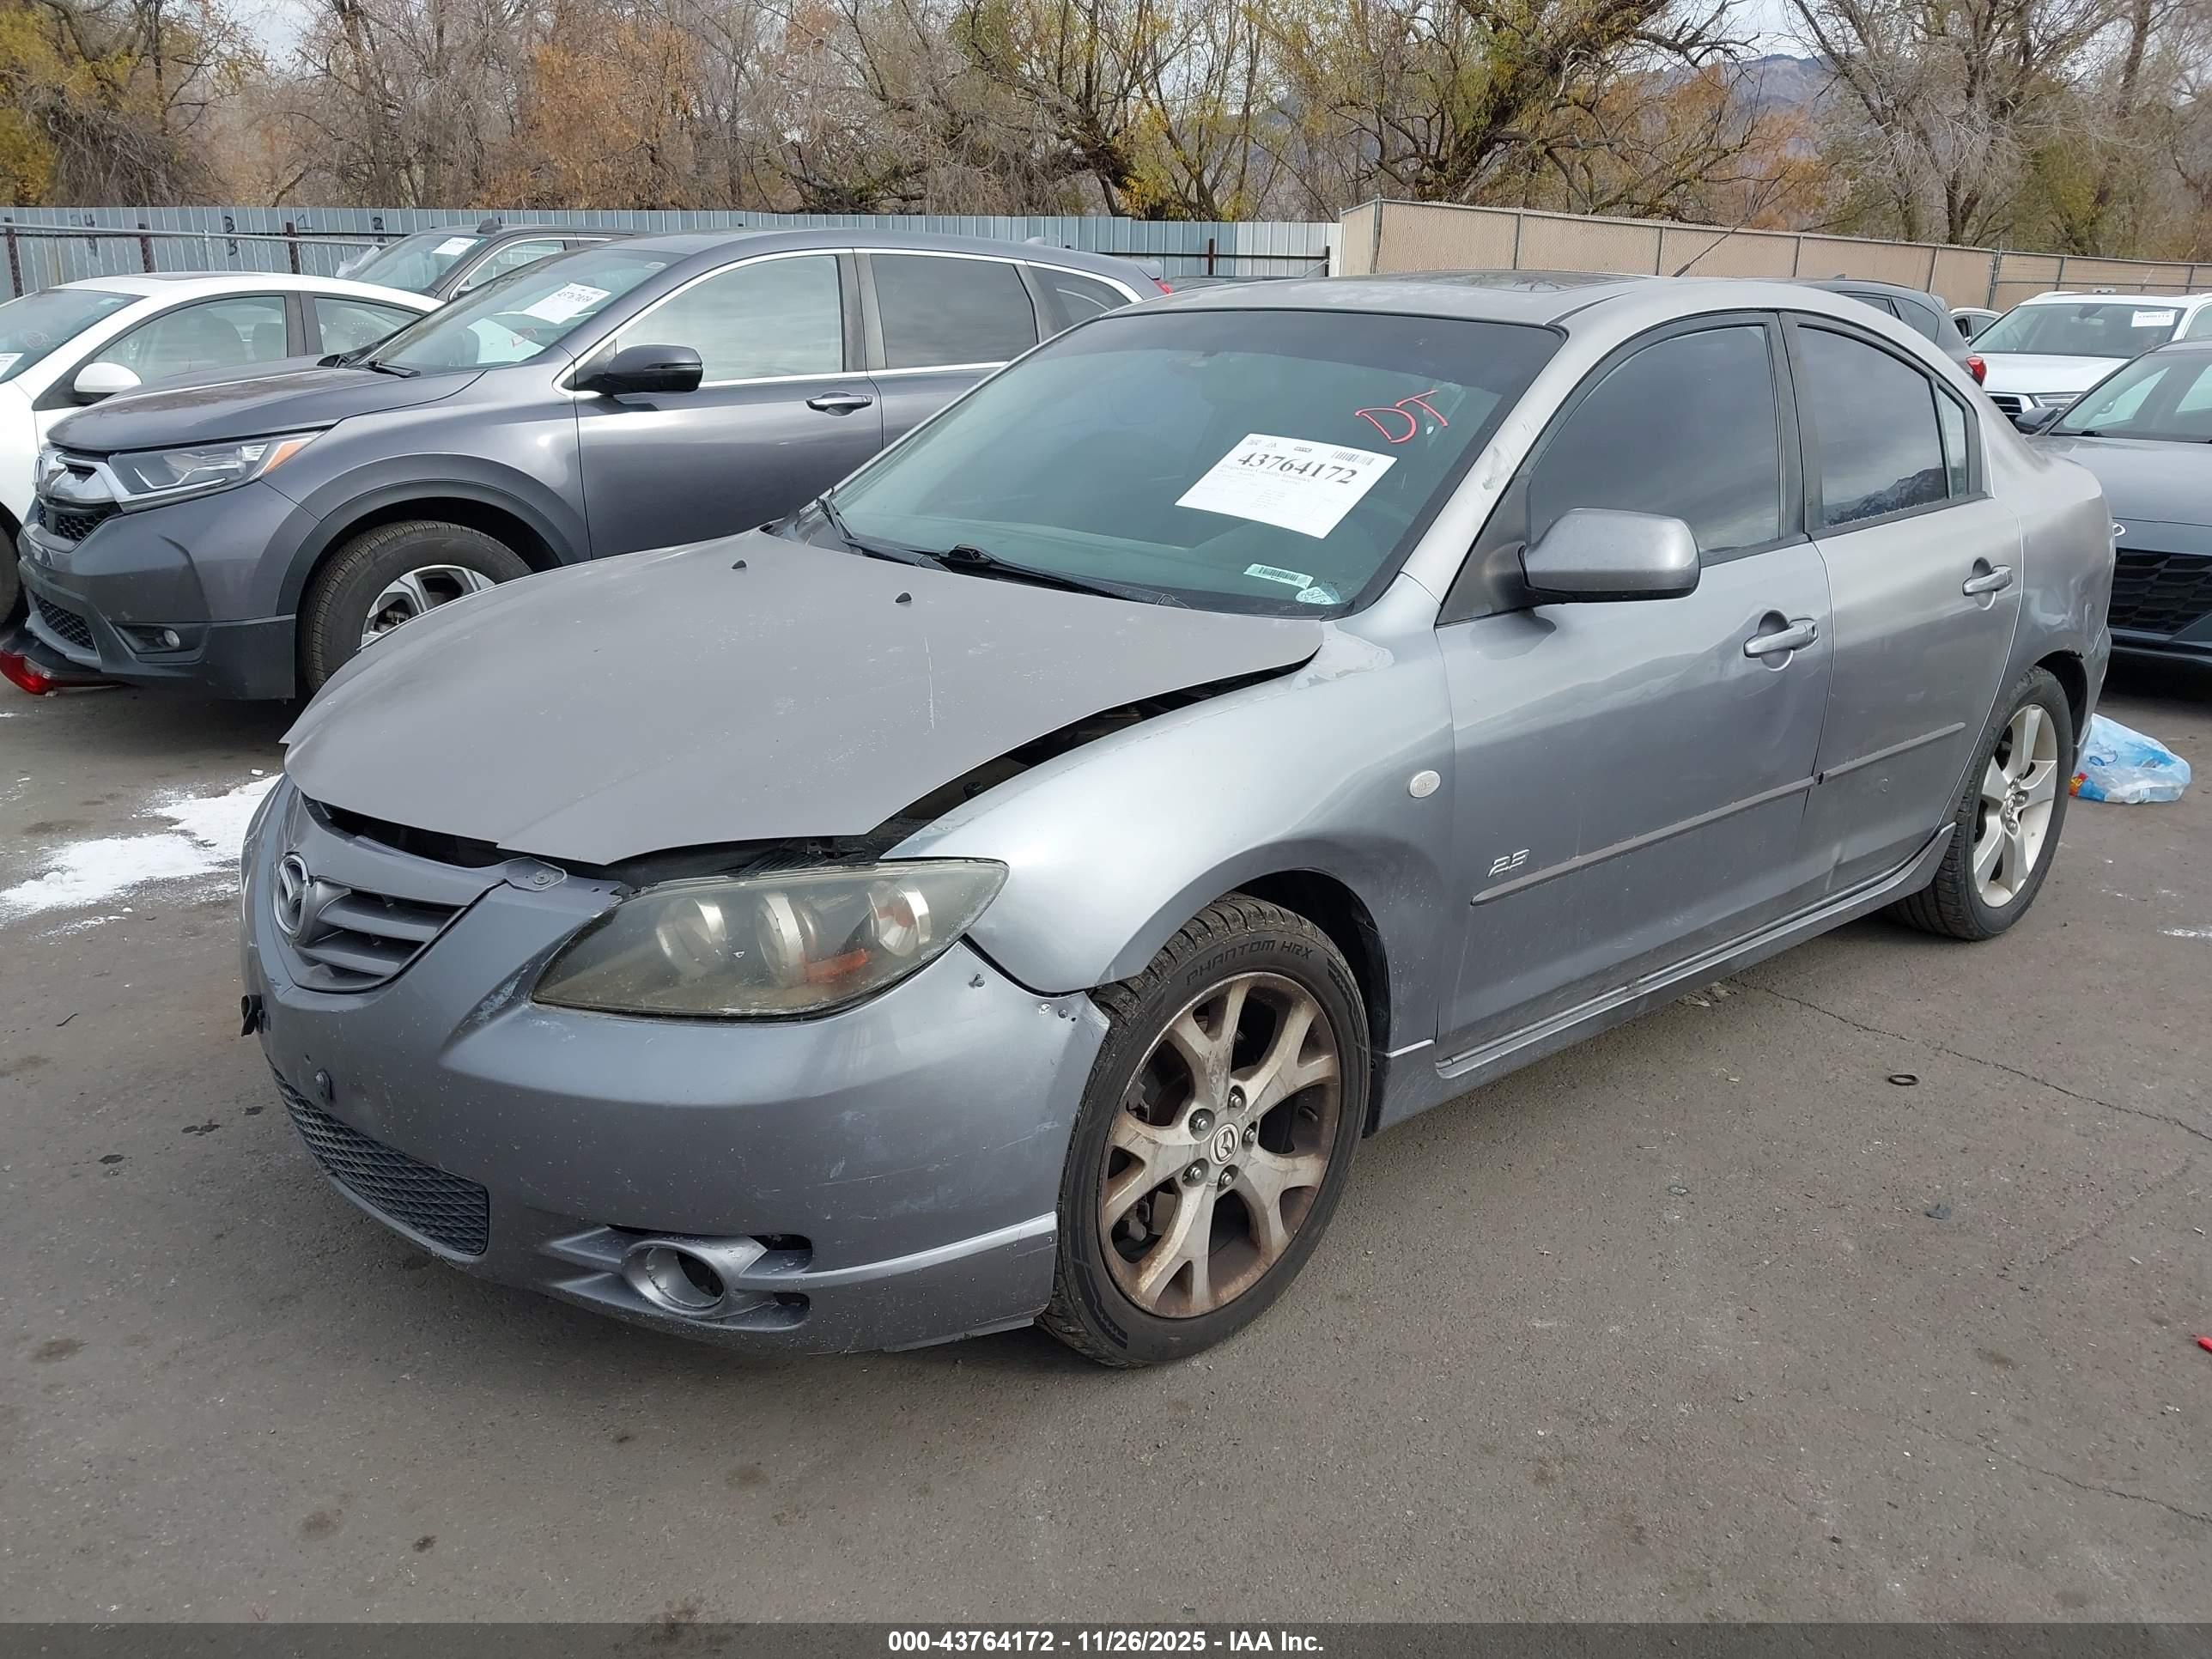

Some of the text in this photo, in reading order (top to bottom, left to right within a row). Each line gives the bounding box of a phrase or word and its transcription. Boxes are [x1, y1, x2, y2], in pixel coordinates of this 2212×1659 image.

[1355, 390, 1449, 444] DT
[1237, 452, 1358, 484] 43764172
[1186, 939, 1315, 986] PHANTOM HRX
